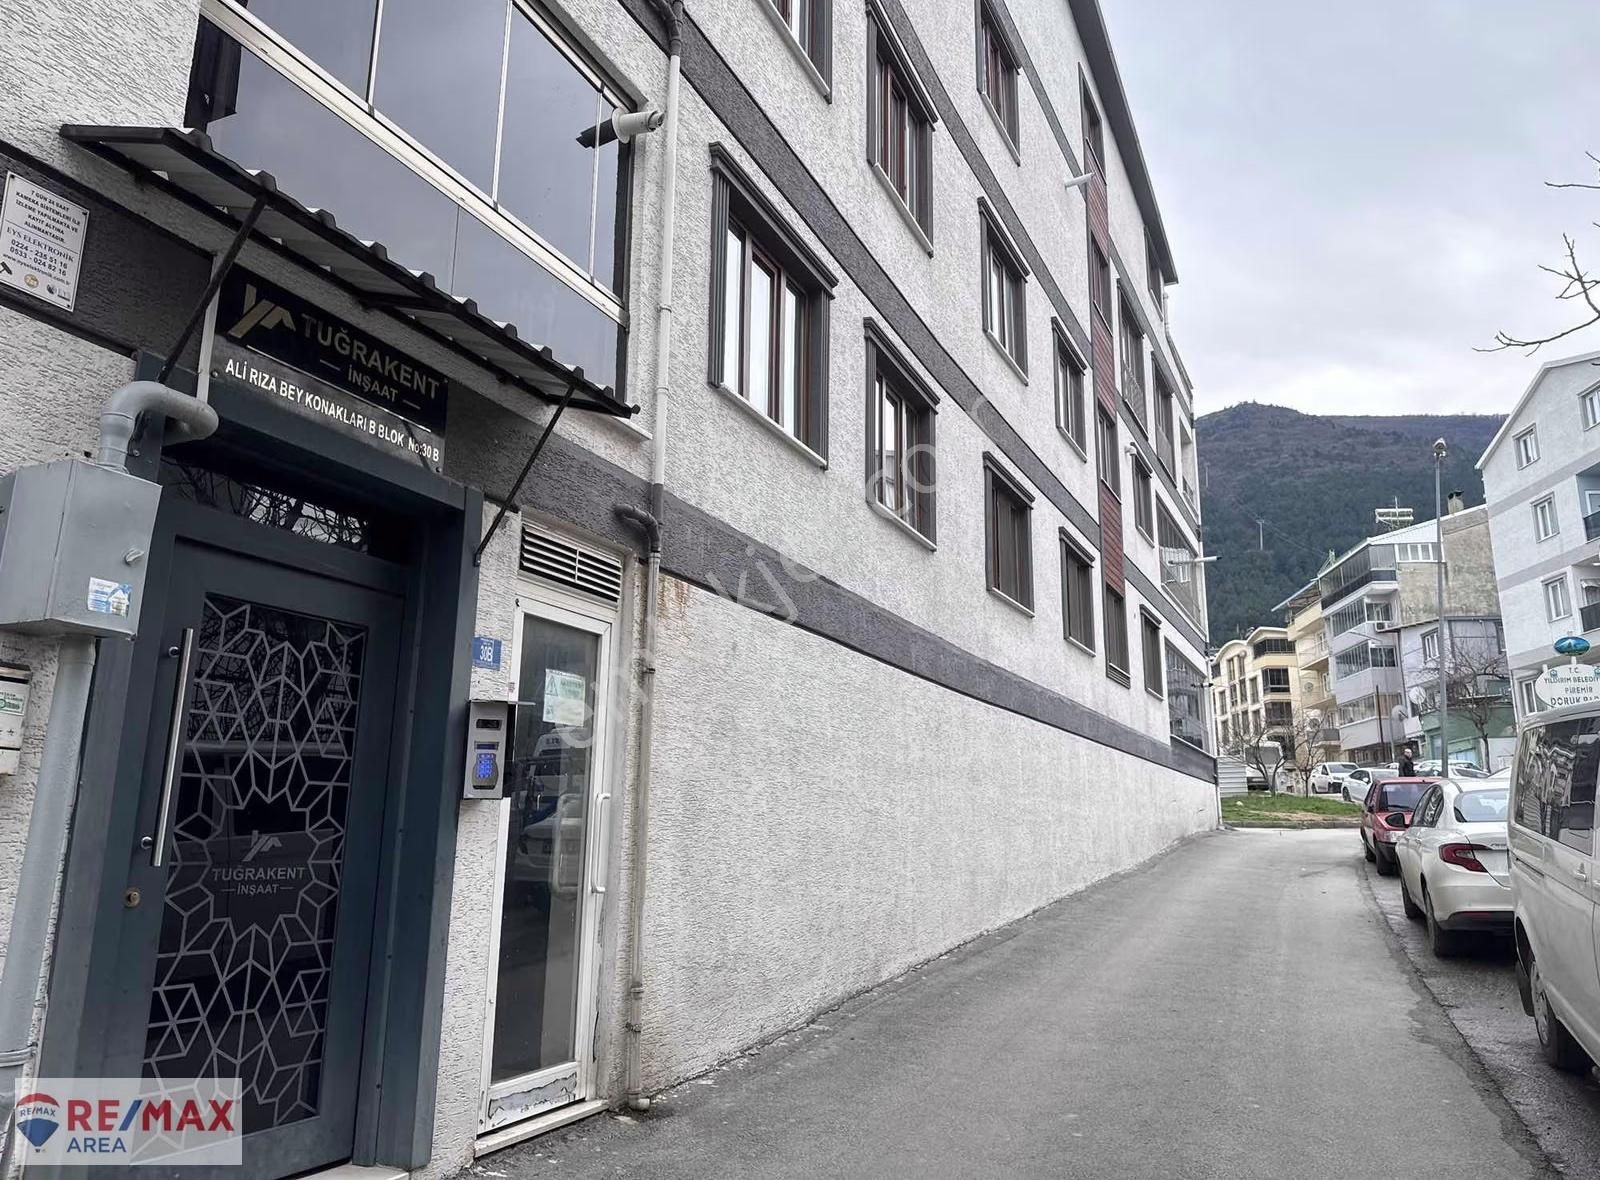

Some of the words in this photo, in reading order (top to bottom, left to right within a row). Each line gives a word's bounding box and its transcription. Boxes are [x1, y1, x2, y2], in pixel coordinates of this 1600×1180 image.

[11, 238, 28, 251] 0224
[301, 313, 440, 399] TUĞRAKENT
[348, 364, 398, 402] İNŞAAT
[225, 359, 248, 380] ALİ
[249, 368, 277, 393] RIZA
[280, 381, 304, 403] BEY
[305, 392, 367, 431] KONAKLARI
[369, 420, 376, 434] B
[378, 424, 405, 447] BLOK
[432, 448, 440, 462] B
[1550, 697, 1581, 705] DORUK
